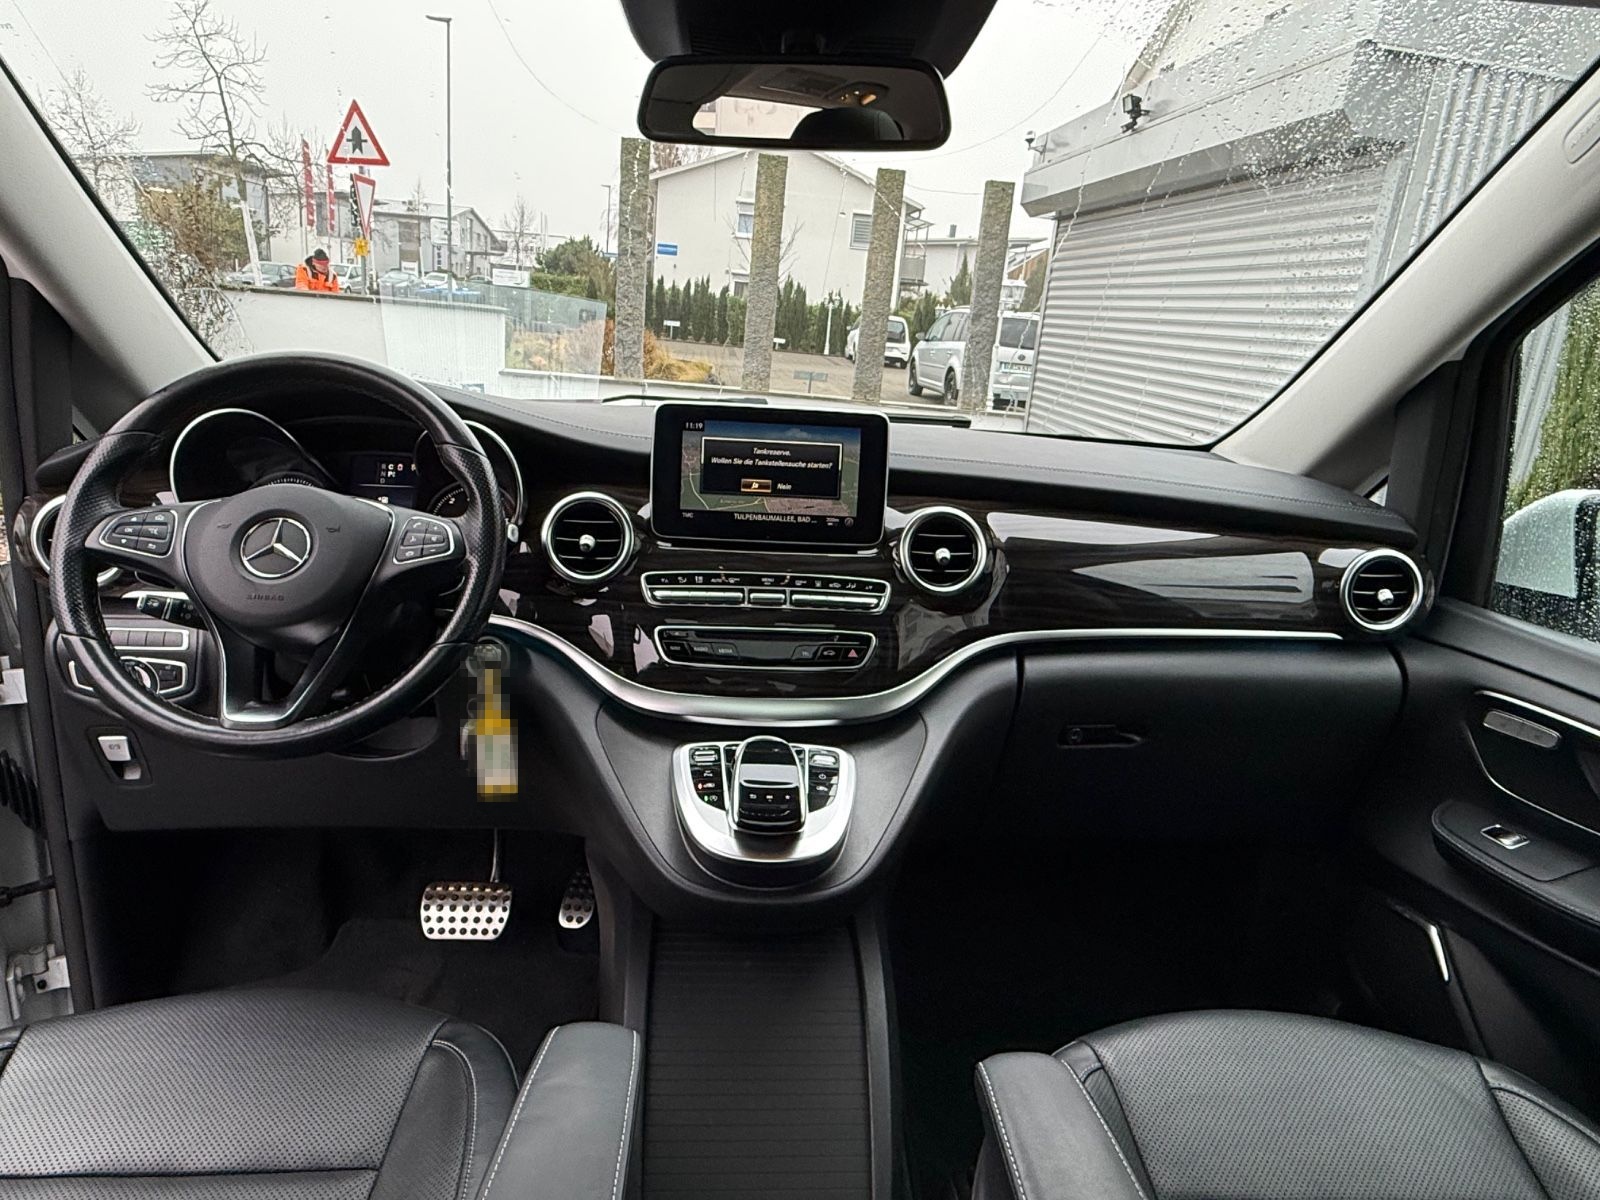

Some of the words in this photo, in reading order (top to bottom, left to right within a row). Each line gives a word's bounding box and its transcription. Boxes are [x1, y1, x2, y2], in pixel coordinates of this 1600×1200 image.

[685, 422, 703, 430] 11:19
[753, 447, 791, 456] Tankreserve.
[711, 456, 732, 465] Wollen
[754, 458, 806, 469] Tankstellensuche
[734, 512, 796, 523] TULPENBAUMALLEE,
